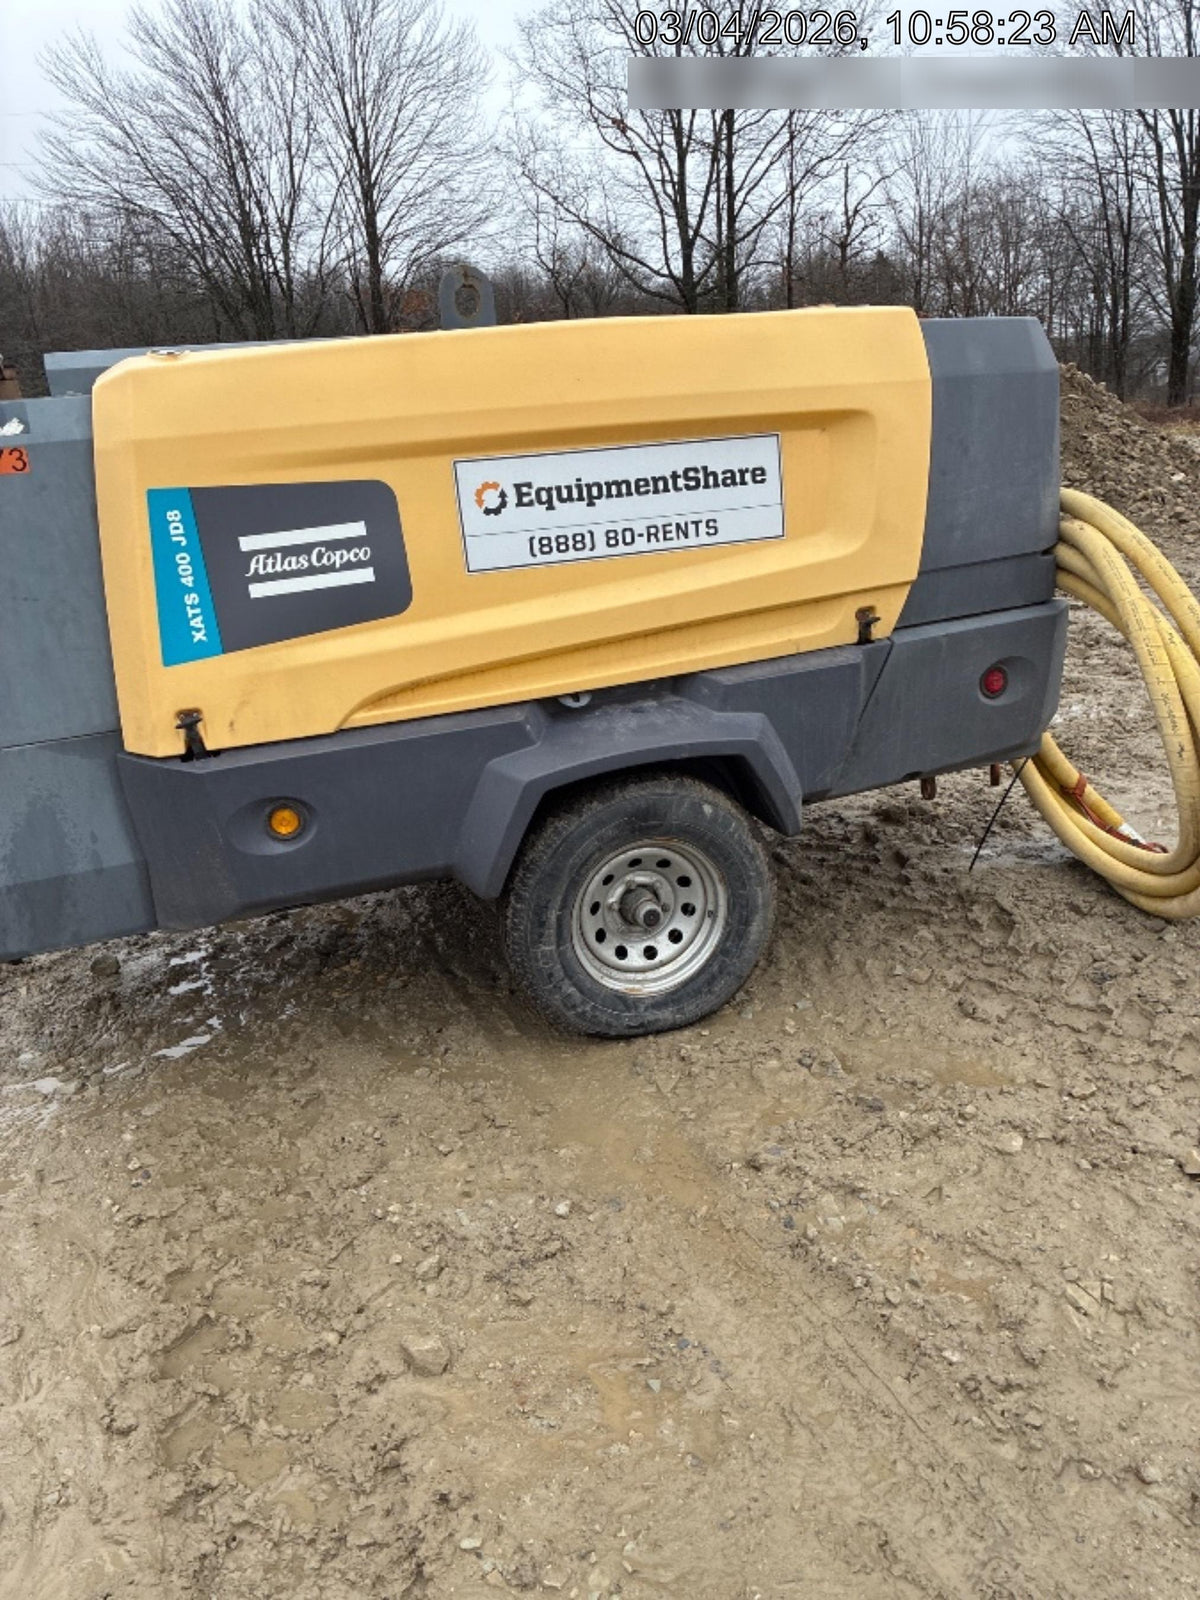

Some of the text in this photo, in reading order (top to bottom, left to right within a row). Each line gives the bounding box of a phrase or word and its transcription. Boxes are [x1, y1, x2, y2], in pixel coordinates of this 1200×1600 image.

[513, 465, 767, 511] EquipmentShare
[528, 518, 719, 557] (888) 80-RENTS
[166, 510, 207, 643] XATS 400 JD8
[245, 547, 371, 577] Atlas Copco
